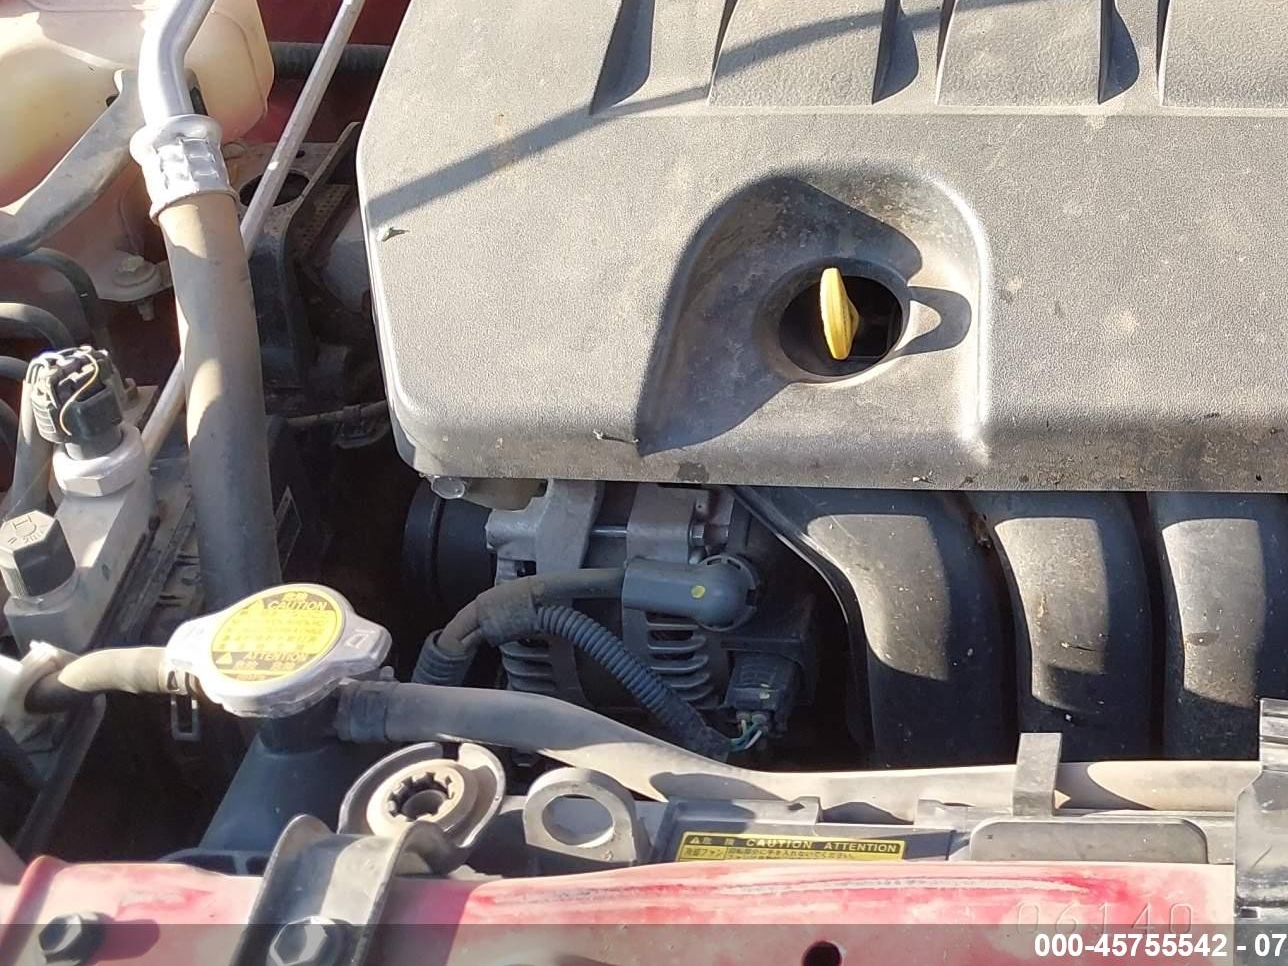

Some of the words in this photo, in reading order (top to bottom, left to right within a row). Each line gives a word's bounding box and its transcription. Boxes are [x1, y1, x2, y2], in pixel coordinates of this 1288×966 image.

[267, 601, 328, 611] CAUTION
[242, 651, 308, 662] ATTENTION
[746, 838, 812, 849] CAUTION
[823, 841, 897, 852] ATTENTION
